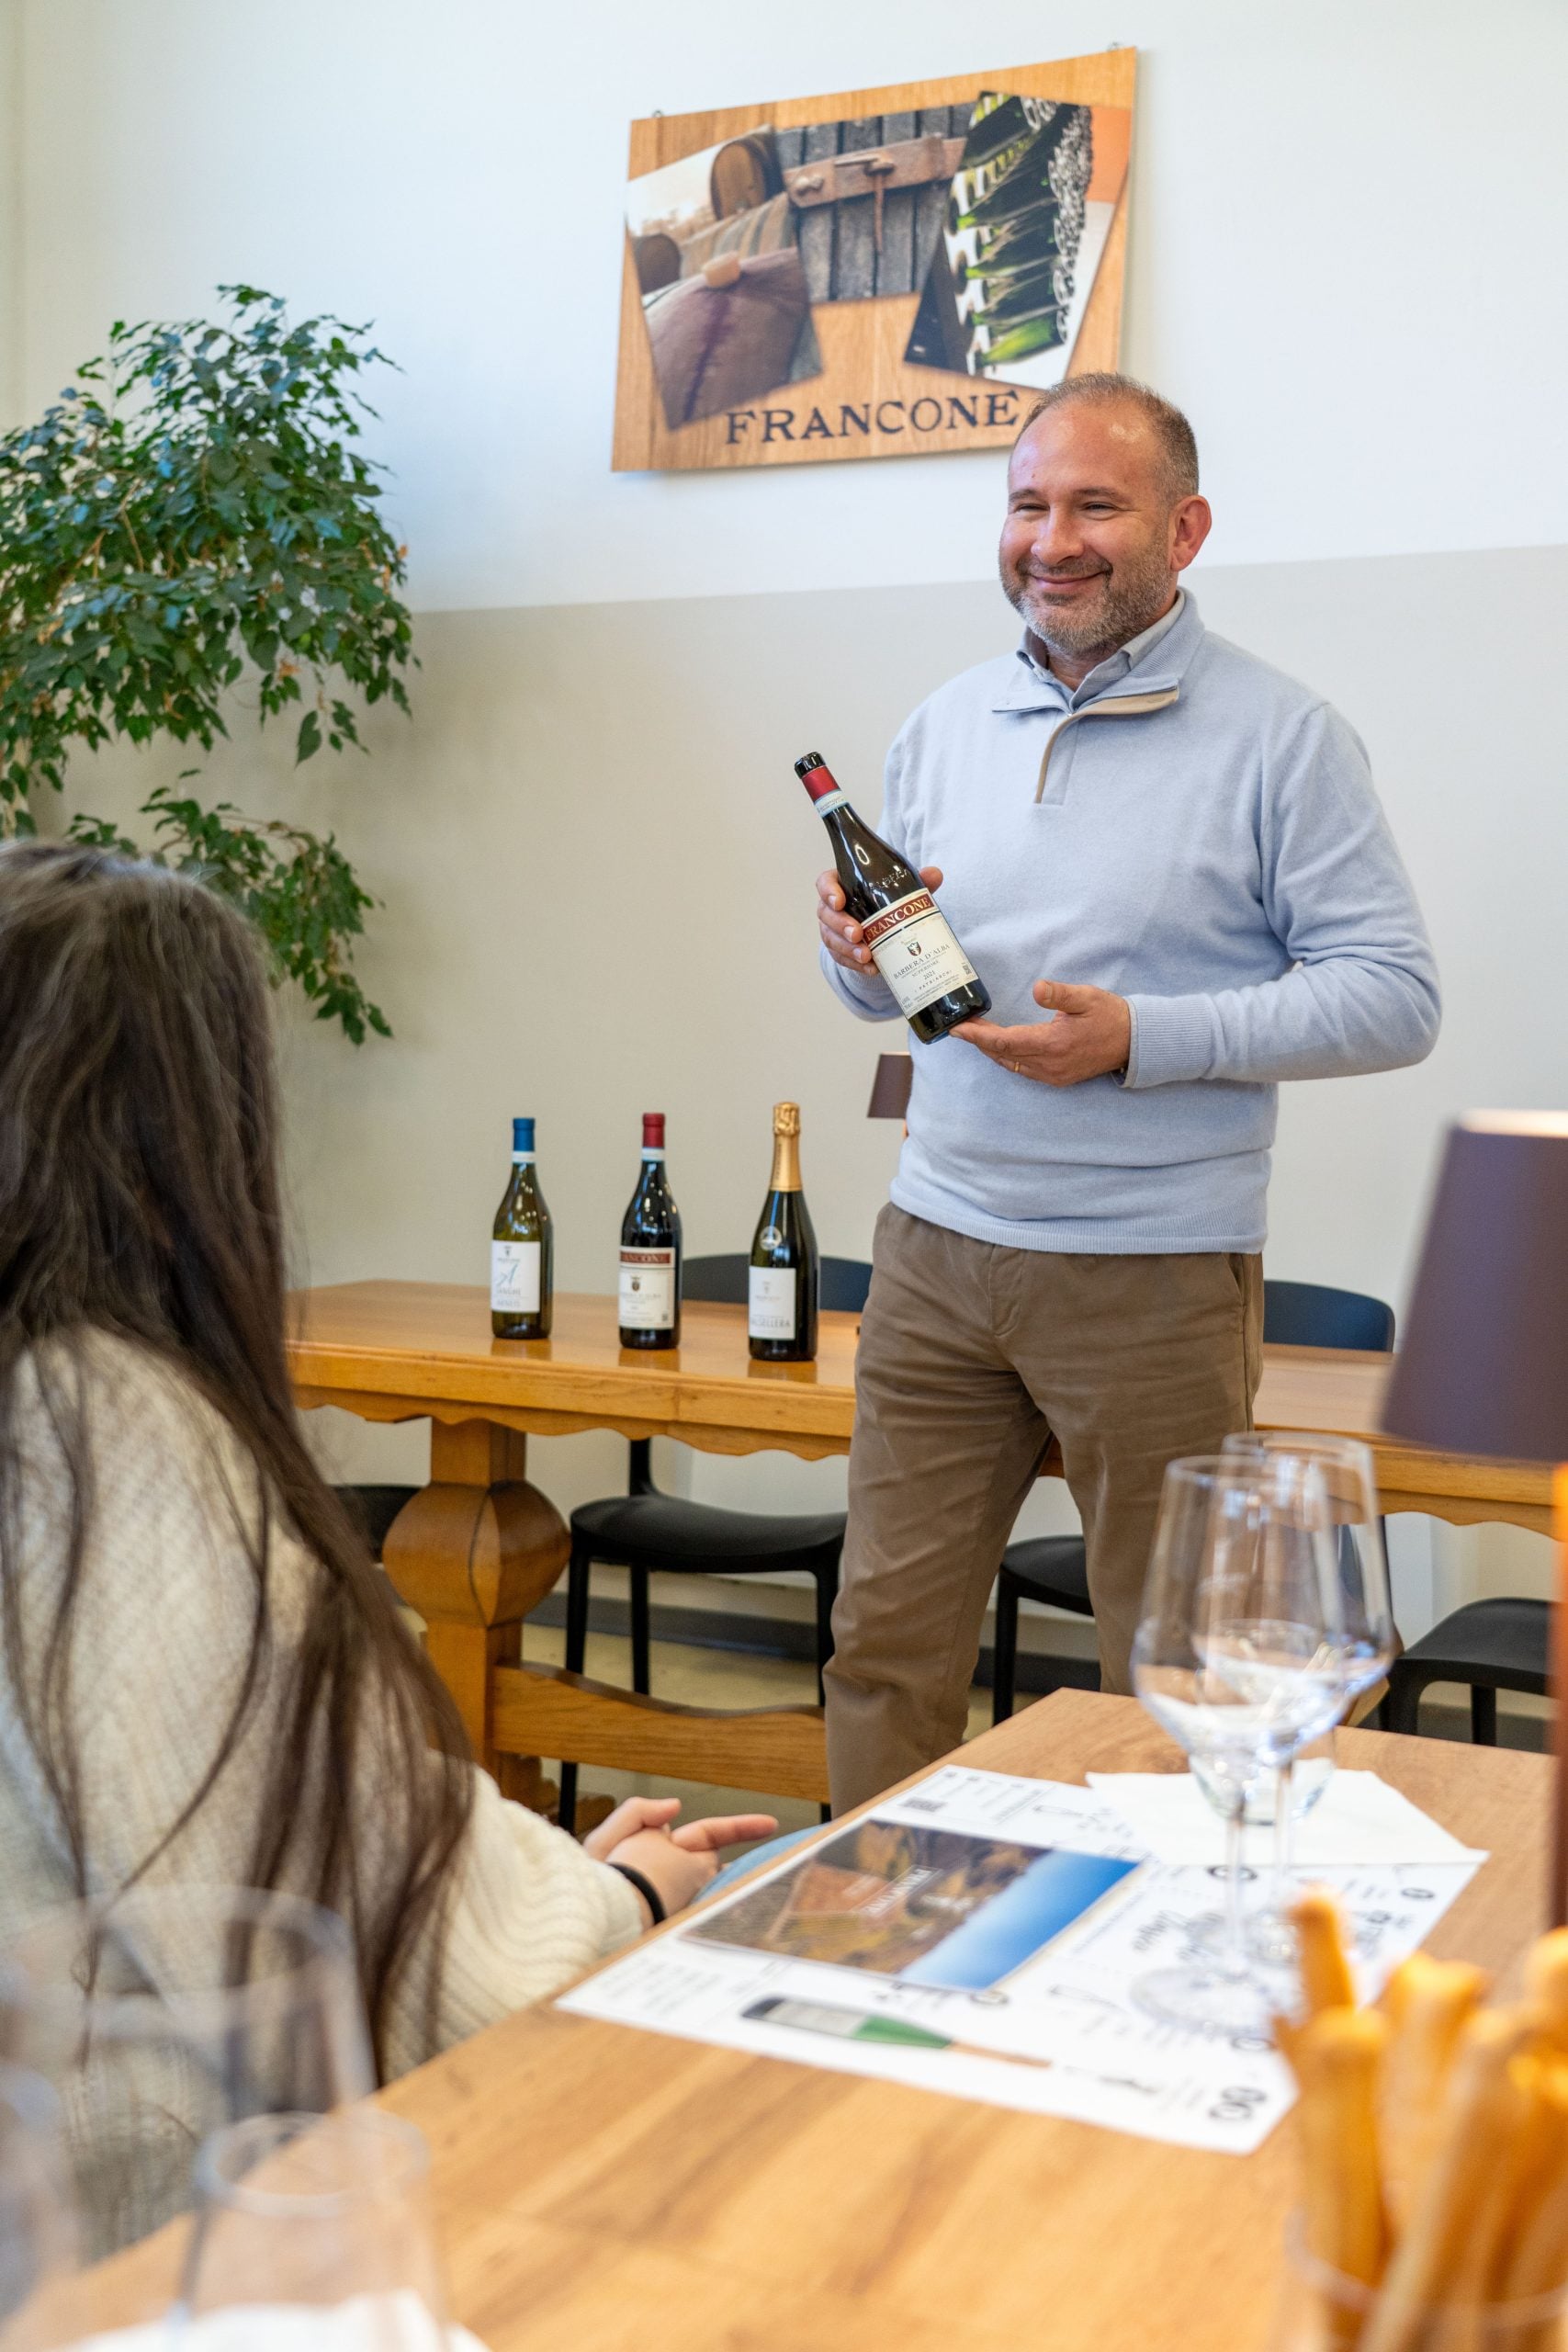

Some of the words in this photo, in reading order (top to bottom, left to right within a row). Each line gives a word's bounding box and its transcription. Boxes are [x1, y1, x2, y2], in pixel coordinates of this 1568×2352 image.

[725, 391, 1020, 445] FRANCONE
[865, 897, 931, 941] FRANCONE
[893, 956, 924, 979] BARBERA
[924, 944, 951, 961] D'ALBA
